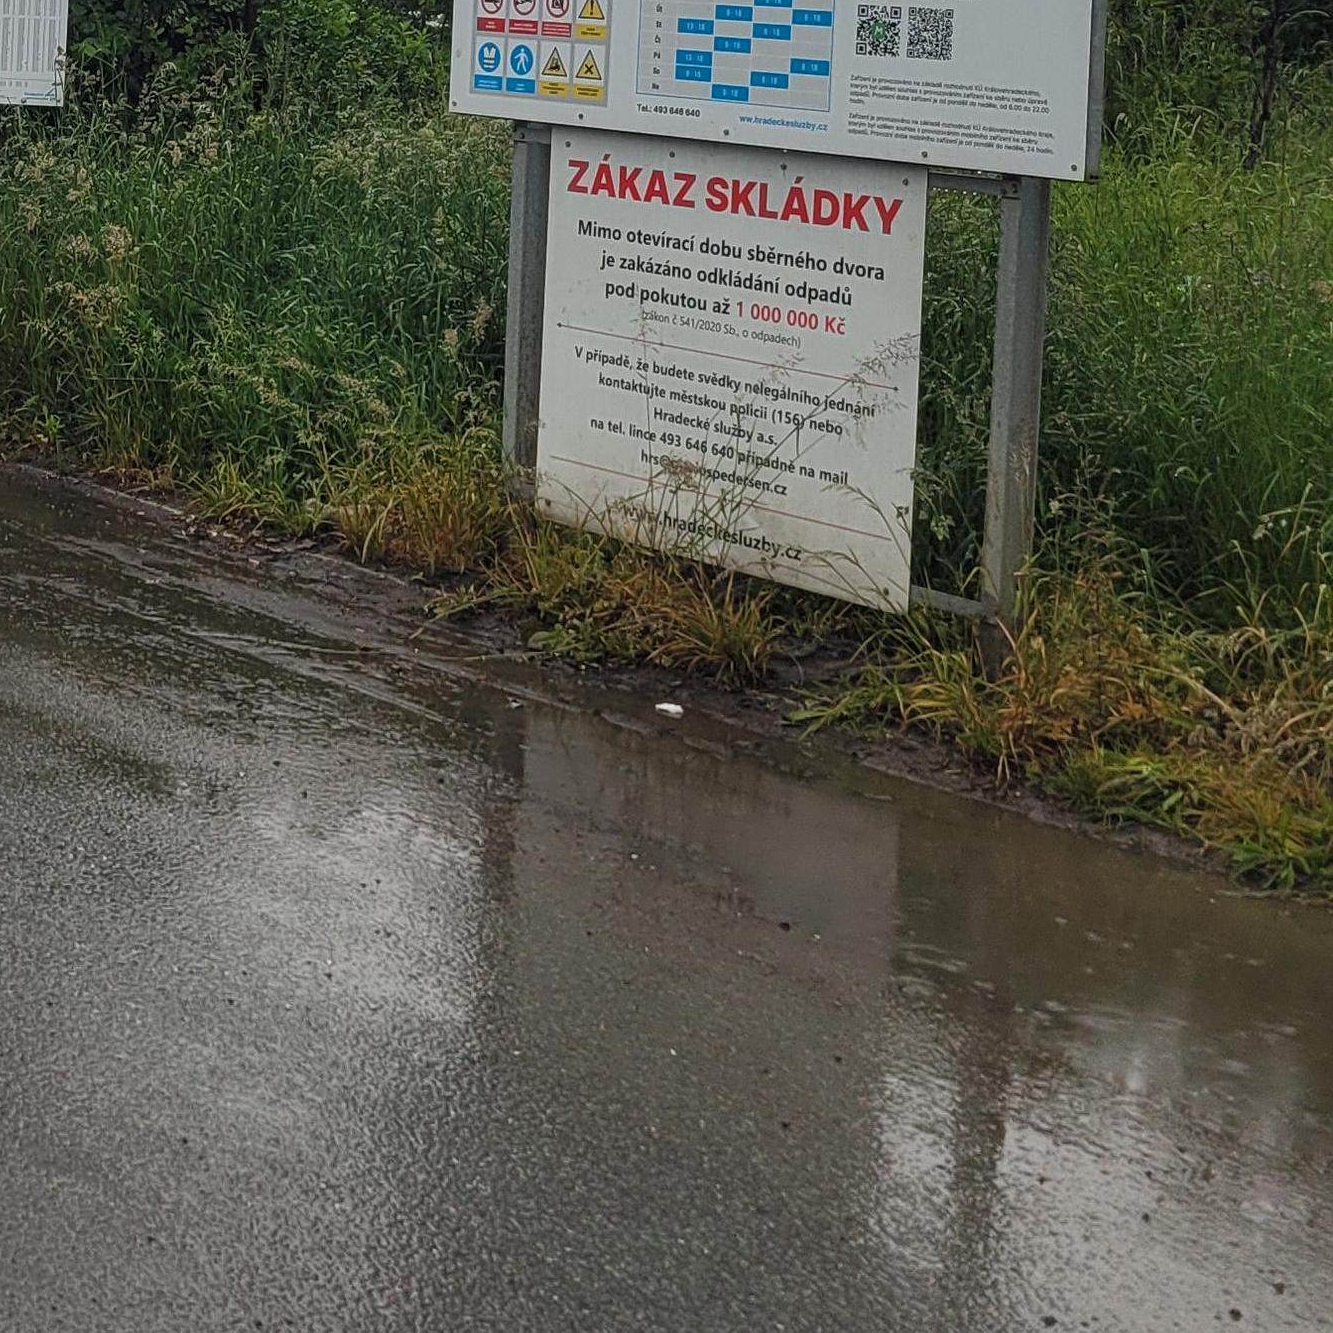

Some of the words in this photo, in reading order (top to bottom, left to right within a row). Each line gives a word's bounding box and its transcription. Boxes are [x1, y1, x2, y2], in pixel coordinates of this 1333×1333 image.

[685, 108, 701, 118] 640
[567, 153, 697, 209] ZÁKAZ
[705, 176, 904, 236] SKLÁDKY
[577, 219, 622, 242] Mimo
[626, 227, 695, 253] otevírací
[699, 237, 742, 261] dobu
[747, 244, 827, 272] sběrného
[832, 256, 885, 281] dvora
[600, 249, 615, 270] je
[619, 254, 692, 280] zakázáno
[697, 265, 780, 295] odkládání
[784, 281, 852, 307] odpadů
[605, 281, 635, 301] pod
[640, 287, 707, 313] pokutou
[712, 297, 731, 315] až
[736, 301, 744, 317] 1
[751, 304, 782, 323] 000
[787, 311, 819, 330] 000
[825, 315, 846, 335] Kč
[679, 316, 722, 334] 541/2020
[751, 327, 801, 349] odpadech)
[574, 345, 583, 359] V
[586, 350, 633, 371] případě,
[636, 358, 650, 372] že
[653, 359, 695, 382] budete
[698, 371, 741, 394] svědky
[744, 379, 821, 407] nelegálního
[823, 396, 876, 418] jednání
[598, 372, 666, 399] kontaktujte
[669, 388, 726, 411] městskou
[730, 402, 768, 424] policii
[772, 408, 806, 430] (156)
[809, 418, 843, 436] nebo
[590, 419, 605, 430] na
[607, 420, 626, 436] tel.
[629, 425, 657, 443] lince
[660, 431, 682, 448] 493
[685, 437, 708, 454] 646
[711, 443, 735, 460] 640
[737, 447, 796, 475] případně
[799, 465, 816, 478] na
[818, 469, 849, 486] mail
[653, 407, 710, 431] Hradecké
[713, 418, 754, 442] služby
[757, 430, 778, 446] a.s.
